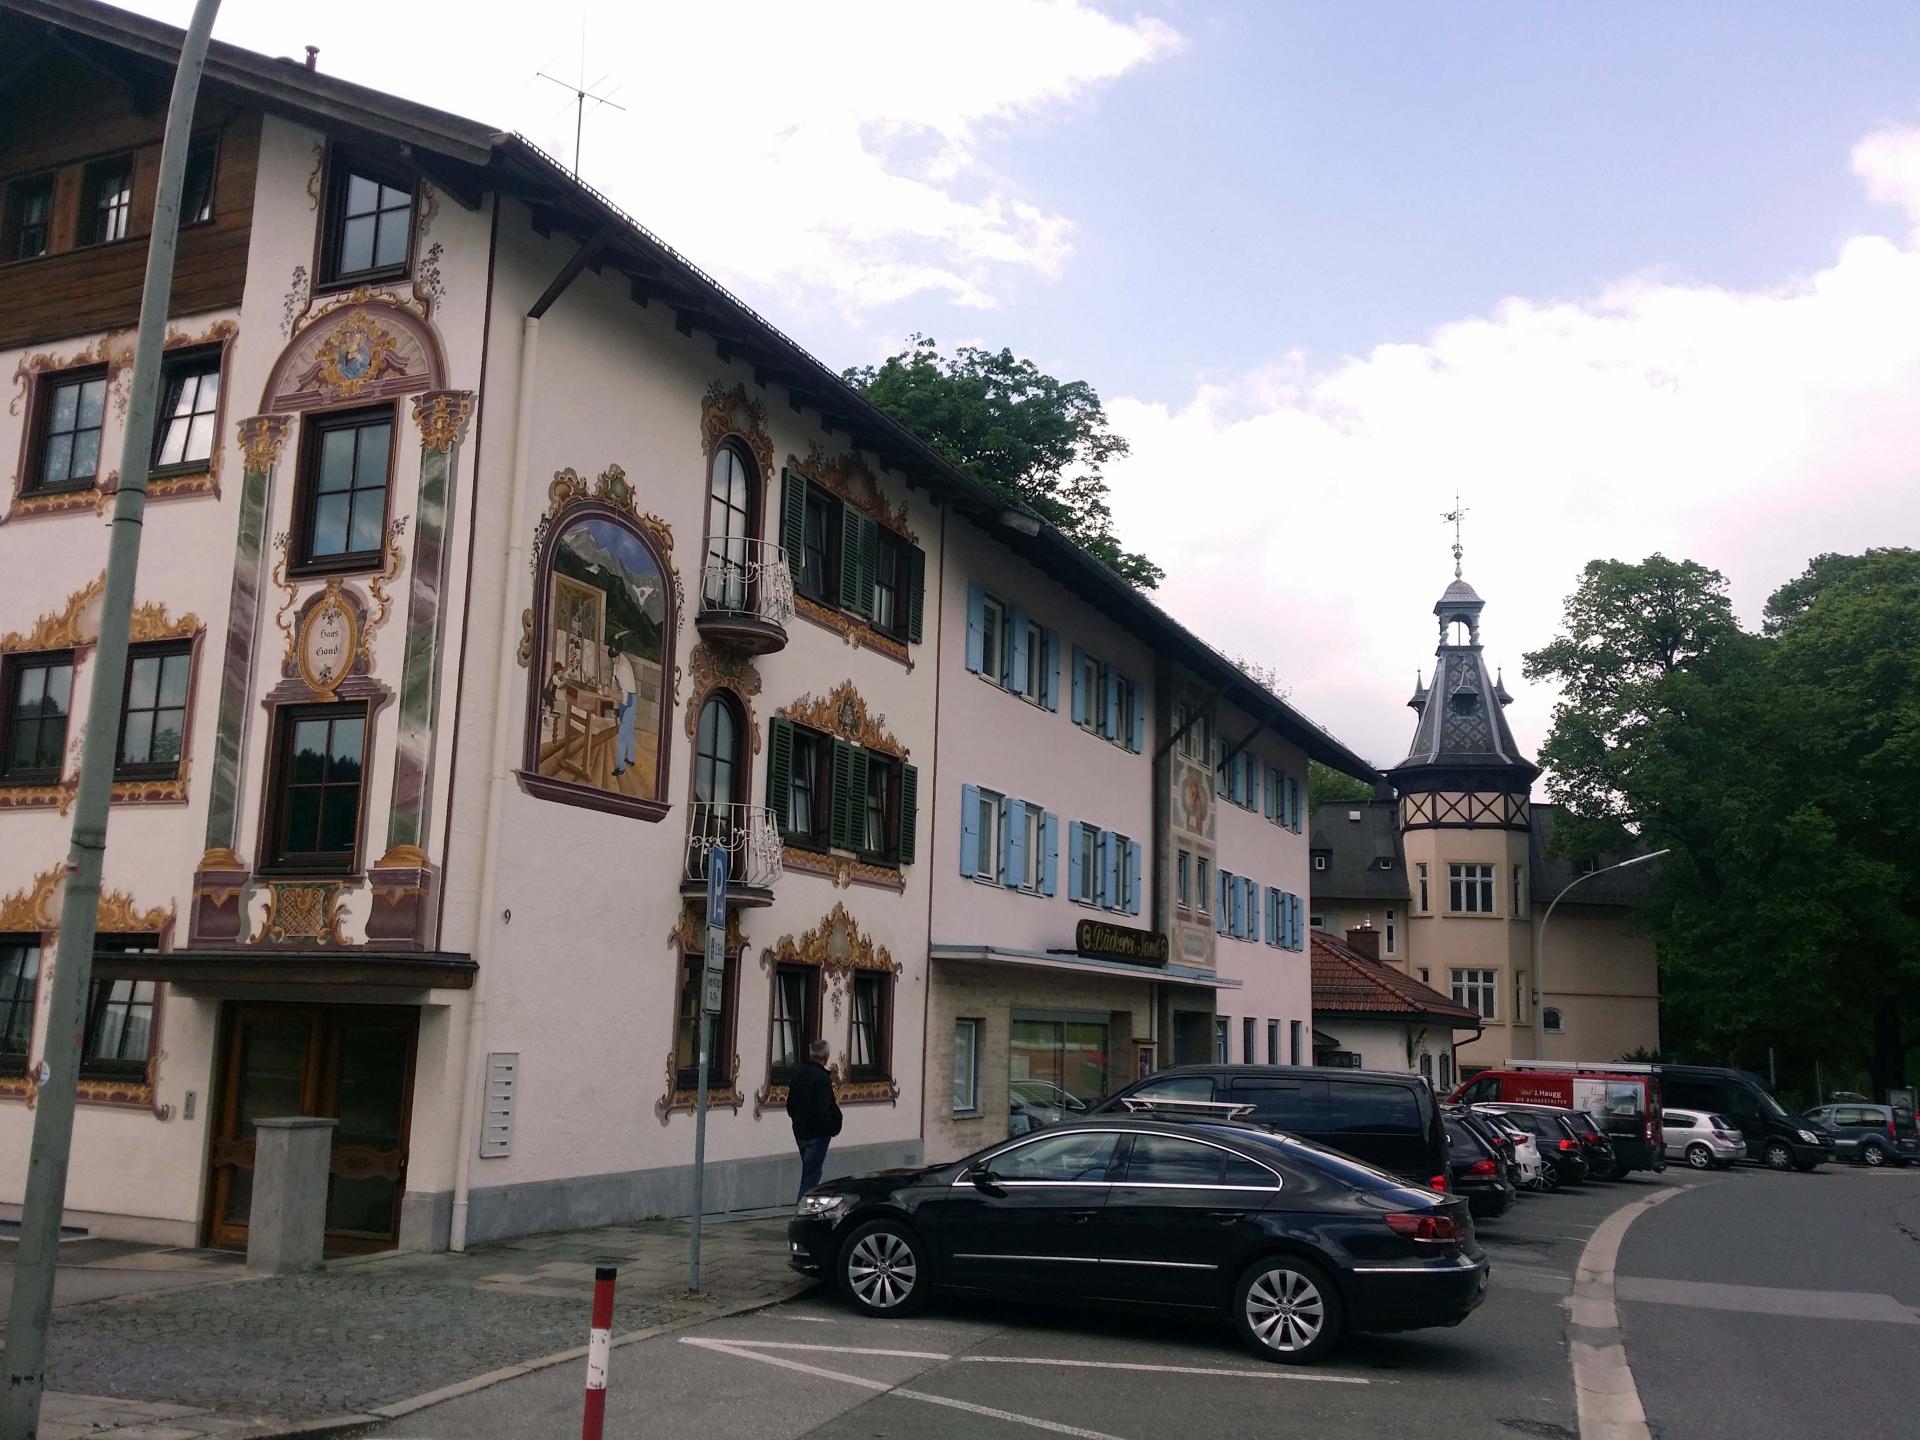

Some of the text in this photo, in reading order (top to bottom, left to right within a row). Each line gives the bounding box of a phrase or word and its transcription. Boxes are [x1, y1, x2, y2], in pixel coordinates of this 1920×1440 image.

[713, 858, 724, 918] P
[504, 909, 511, 924] 9
[1093, 924, 1136, 954] Bäckerei
[1539, 1090, 1562, 1099] Haugg
